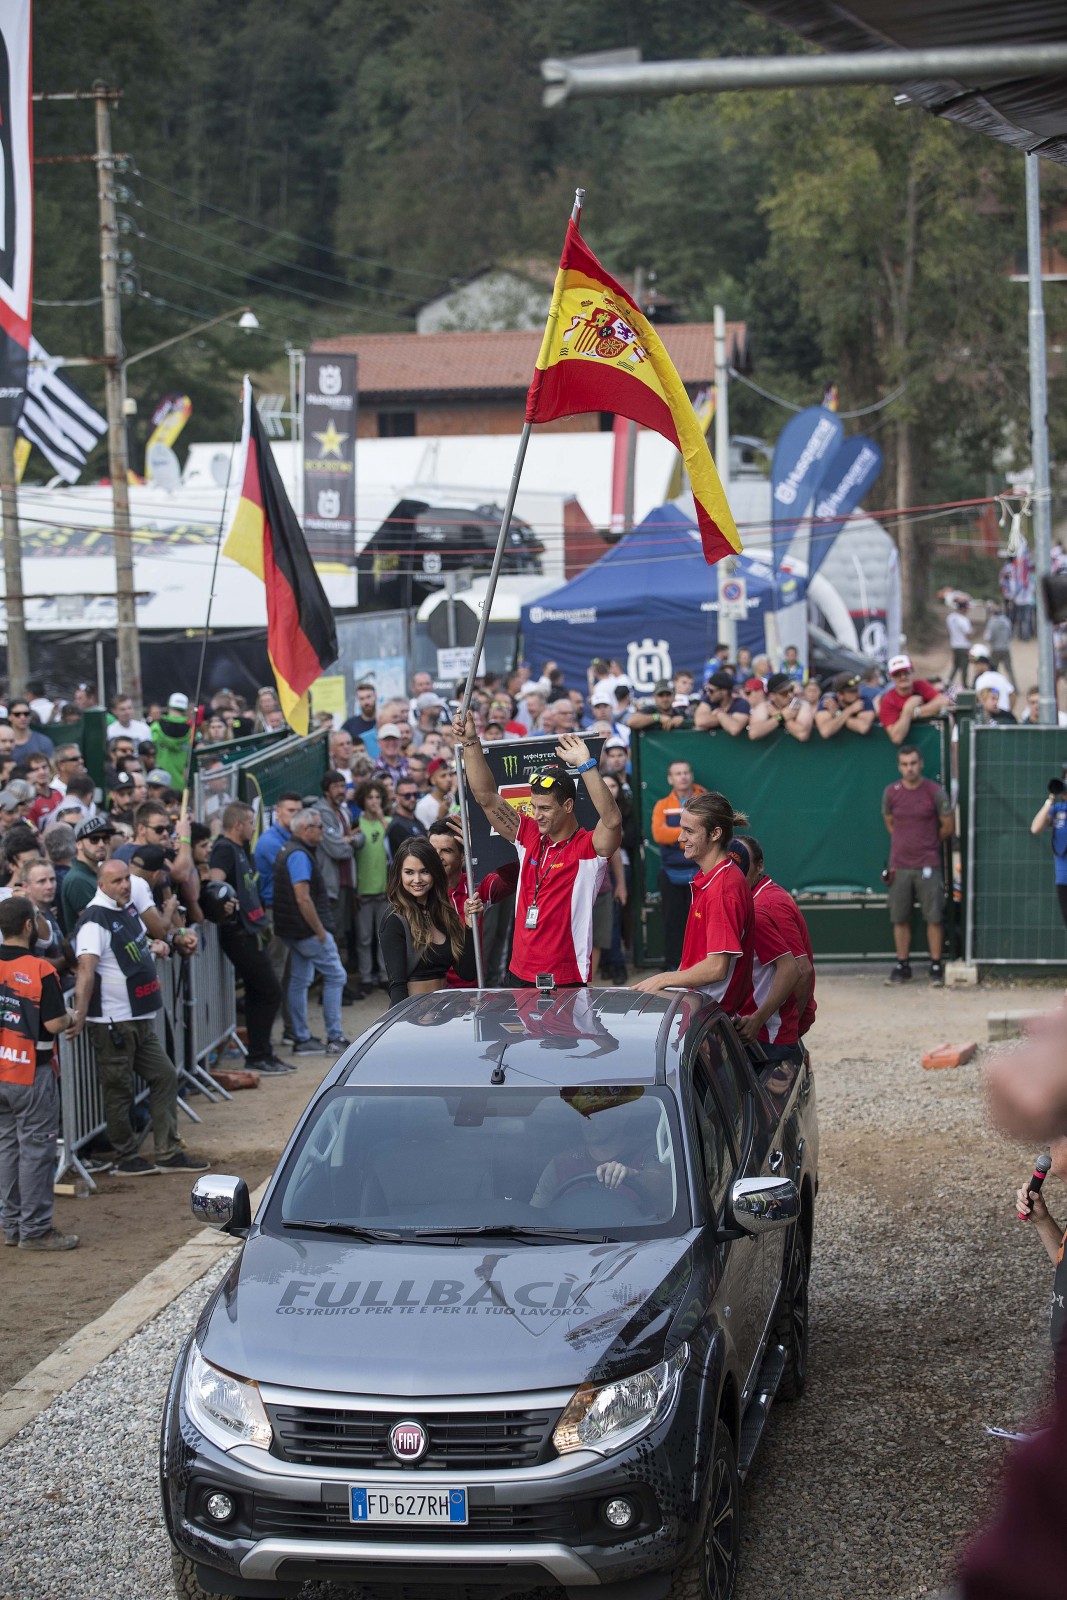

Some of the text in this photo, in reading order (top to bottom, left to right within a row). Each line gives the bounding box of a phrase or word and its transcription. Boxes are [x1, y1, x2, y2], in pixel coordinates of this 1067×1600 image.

[278, 1279, 592, 1309] FULLBACK
[275, 1306, 590, 1317] COSTRUITO PER TE E PER IL TUO LAVORO.
[398, 1432, 419, 1450] FIAT
